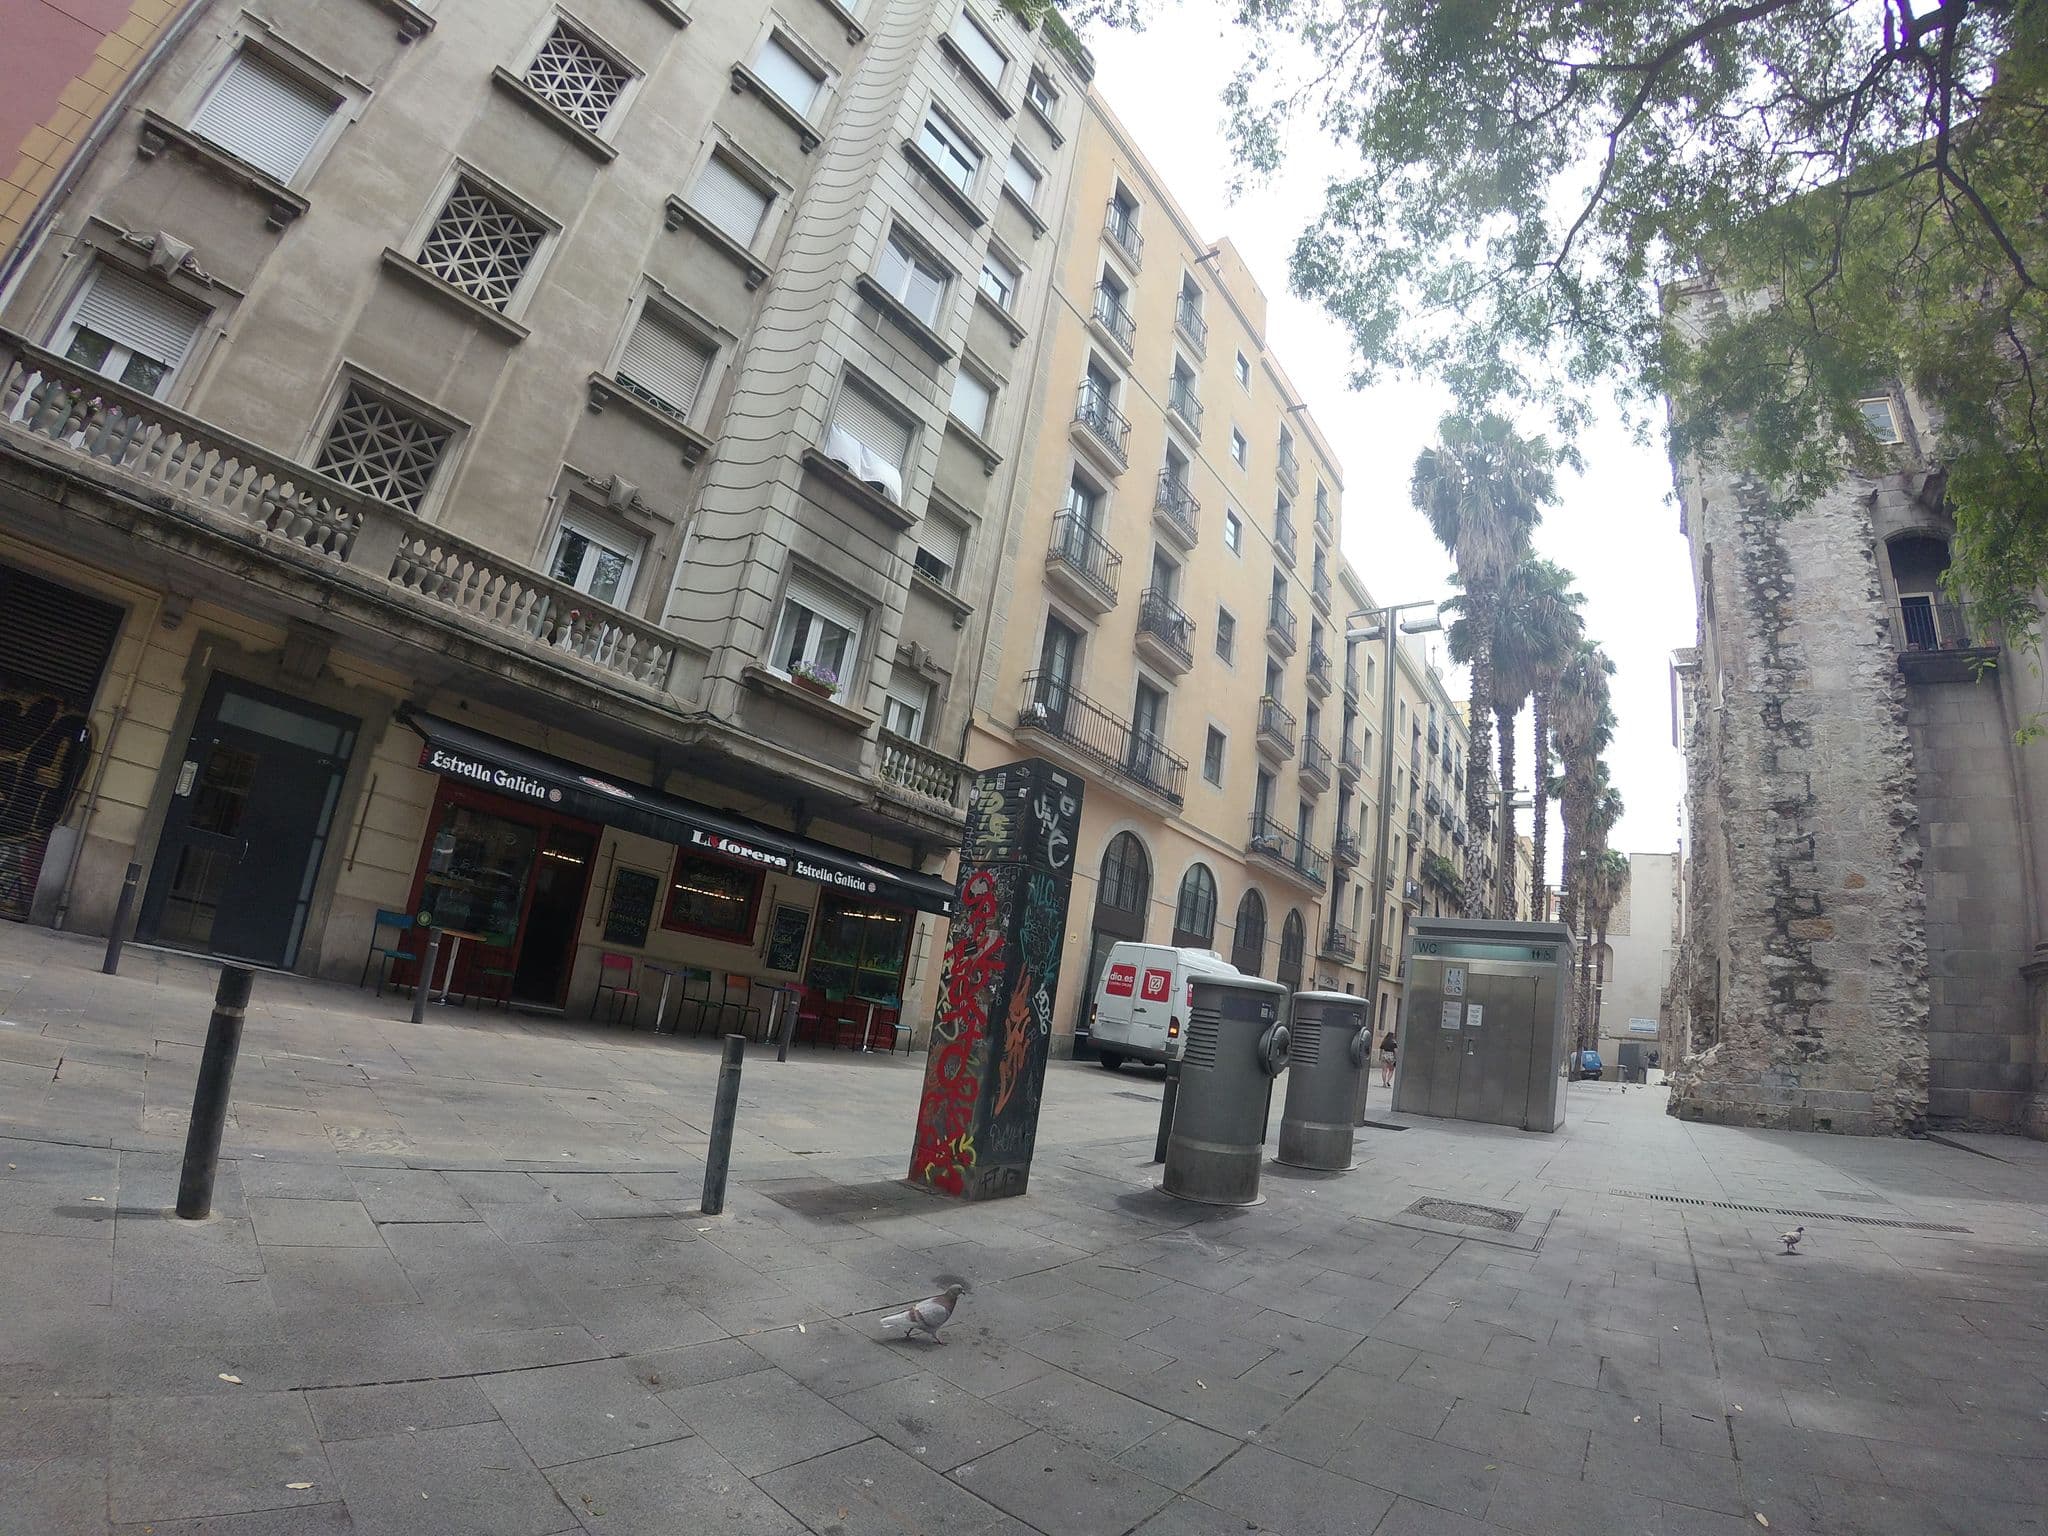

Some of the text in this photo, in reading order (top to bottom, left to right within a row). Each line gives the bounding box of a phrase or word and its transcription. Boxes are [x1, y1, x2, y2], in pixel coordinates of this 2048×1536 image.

[430, 750, 546, 799] Estrella Galicia
[795, 860, 867, 892] Estrella Galicia
[1418, 943, 1438, 954] WC
